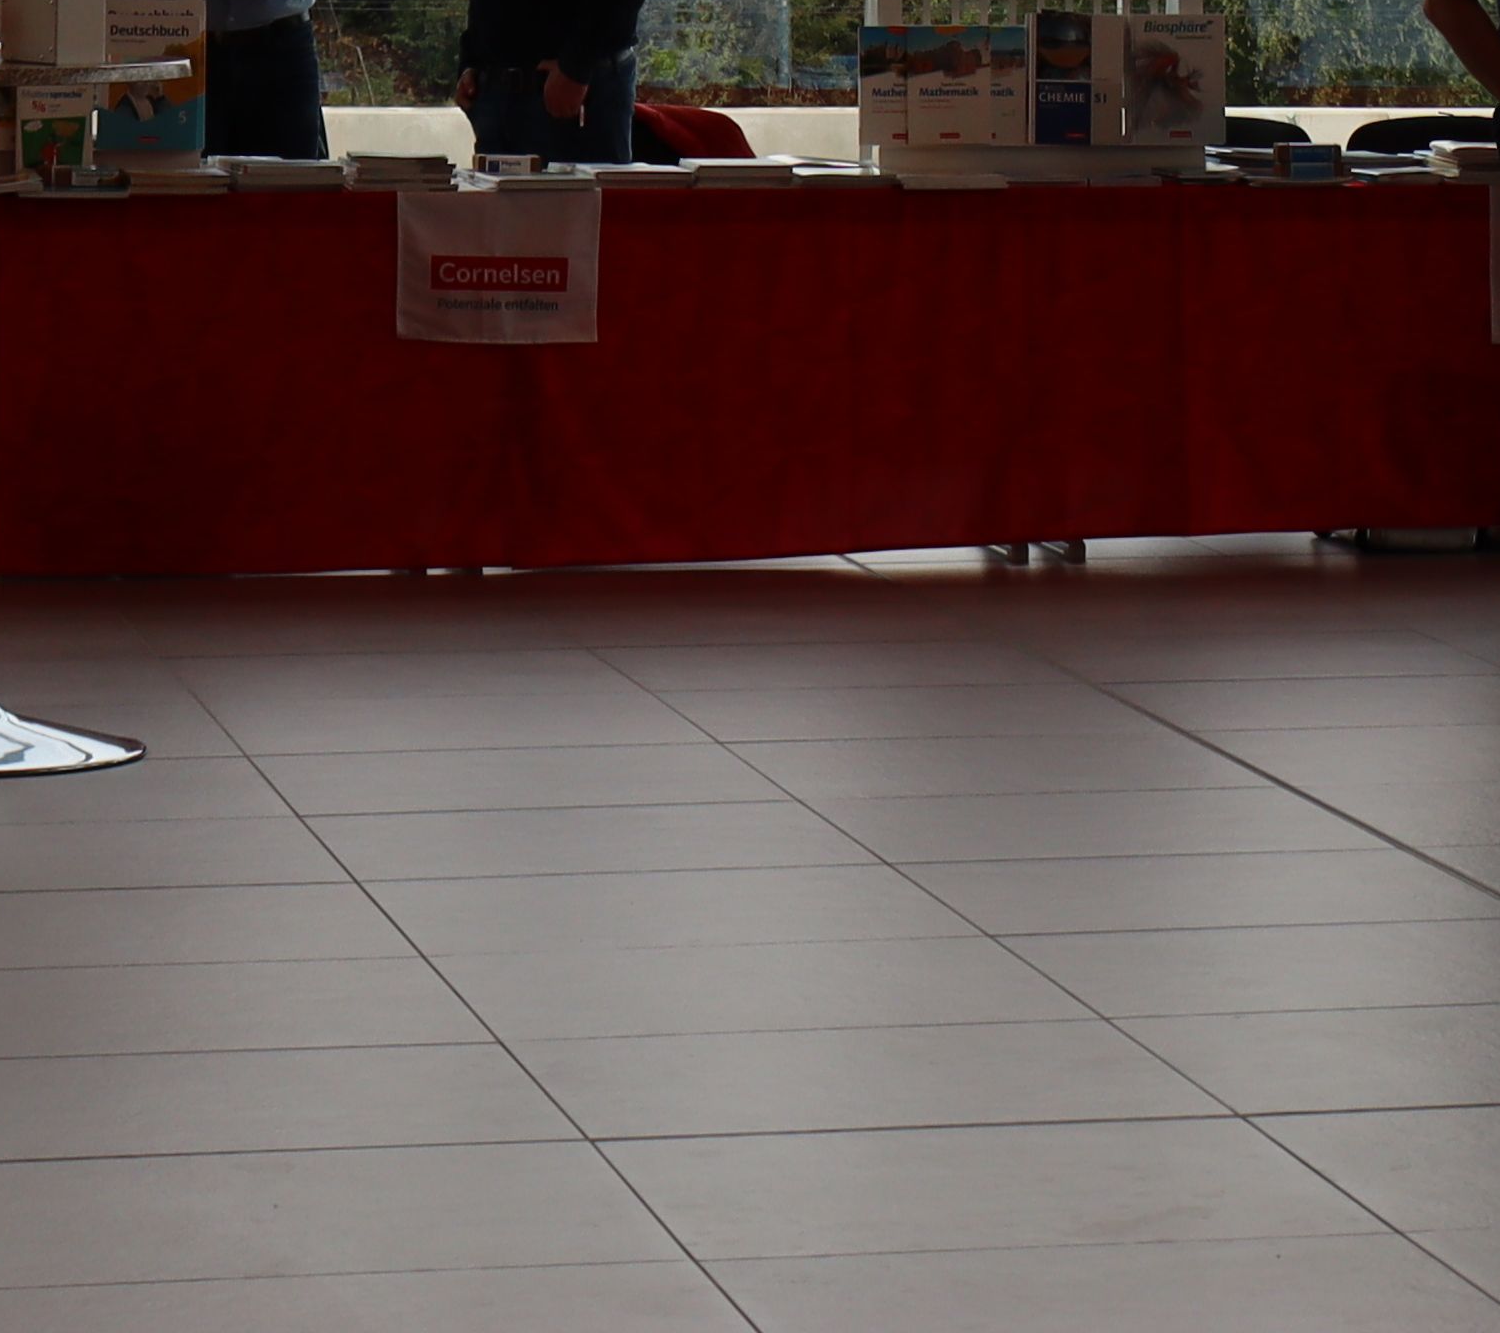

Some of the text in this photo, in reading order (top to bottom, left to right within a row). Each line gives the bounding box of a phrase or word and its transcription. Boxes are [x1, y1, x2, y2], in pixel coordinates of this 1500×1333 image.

[109, 25, 190, 38] Deutschbuch
[1143, 20, 1207, 34] Biosphäre
[919, 88, 979, 97] Mathematik
[1039, 92, 1085, 103] CHEMIE
[438, 261, 560, 285] Cornelsen
